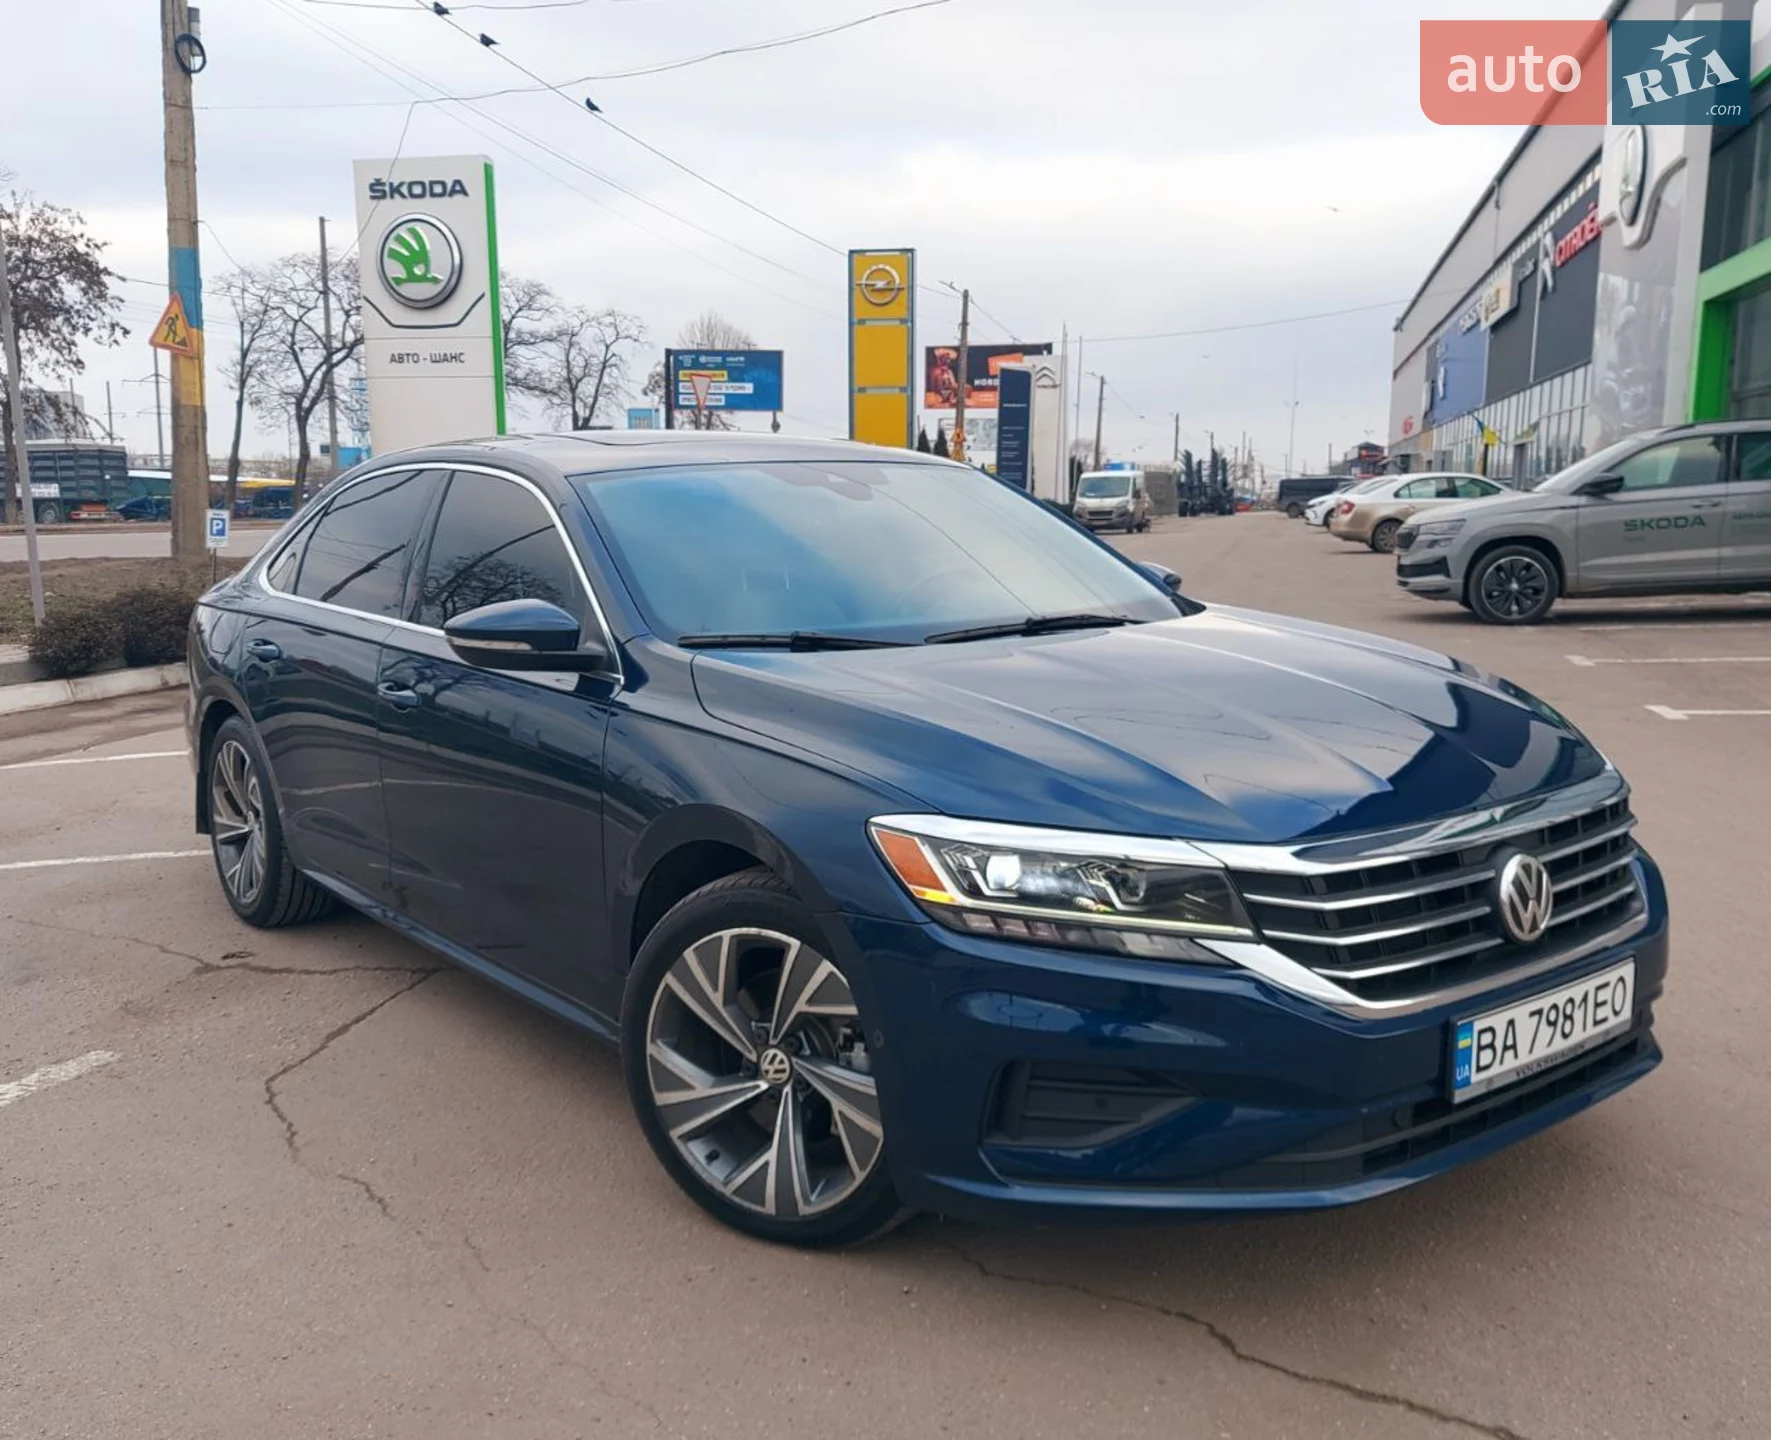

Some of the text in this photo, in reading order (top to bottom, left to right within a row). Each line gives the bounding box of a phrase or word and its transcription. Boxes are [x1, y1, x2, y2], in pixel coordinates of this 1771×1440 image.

[369, 178, 469, 200] ŠKODA
[1555, 201, 1604, 267] CITROË
[389, 353, 420, 364] АВТО
[430, 352, 465, 364] ШАНС
[212, 519, 223, 535] P
[1475, 1018, 1519, 1074] BA
[1456, 1065, 1470, 1081] UA
